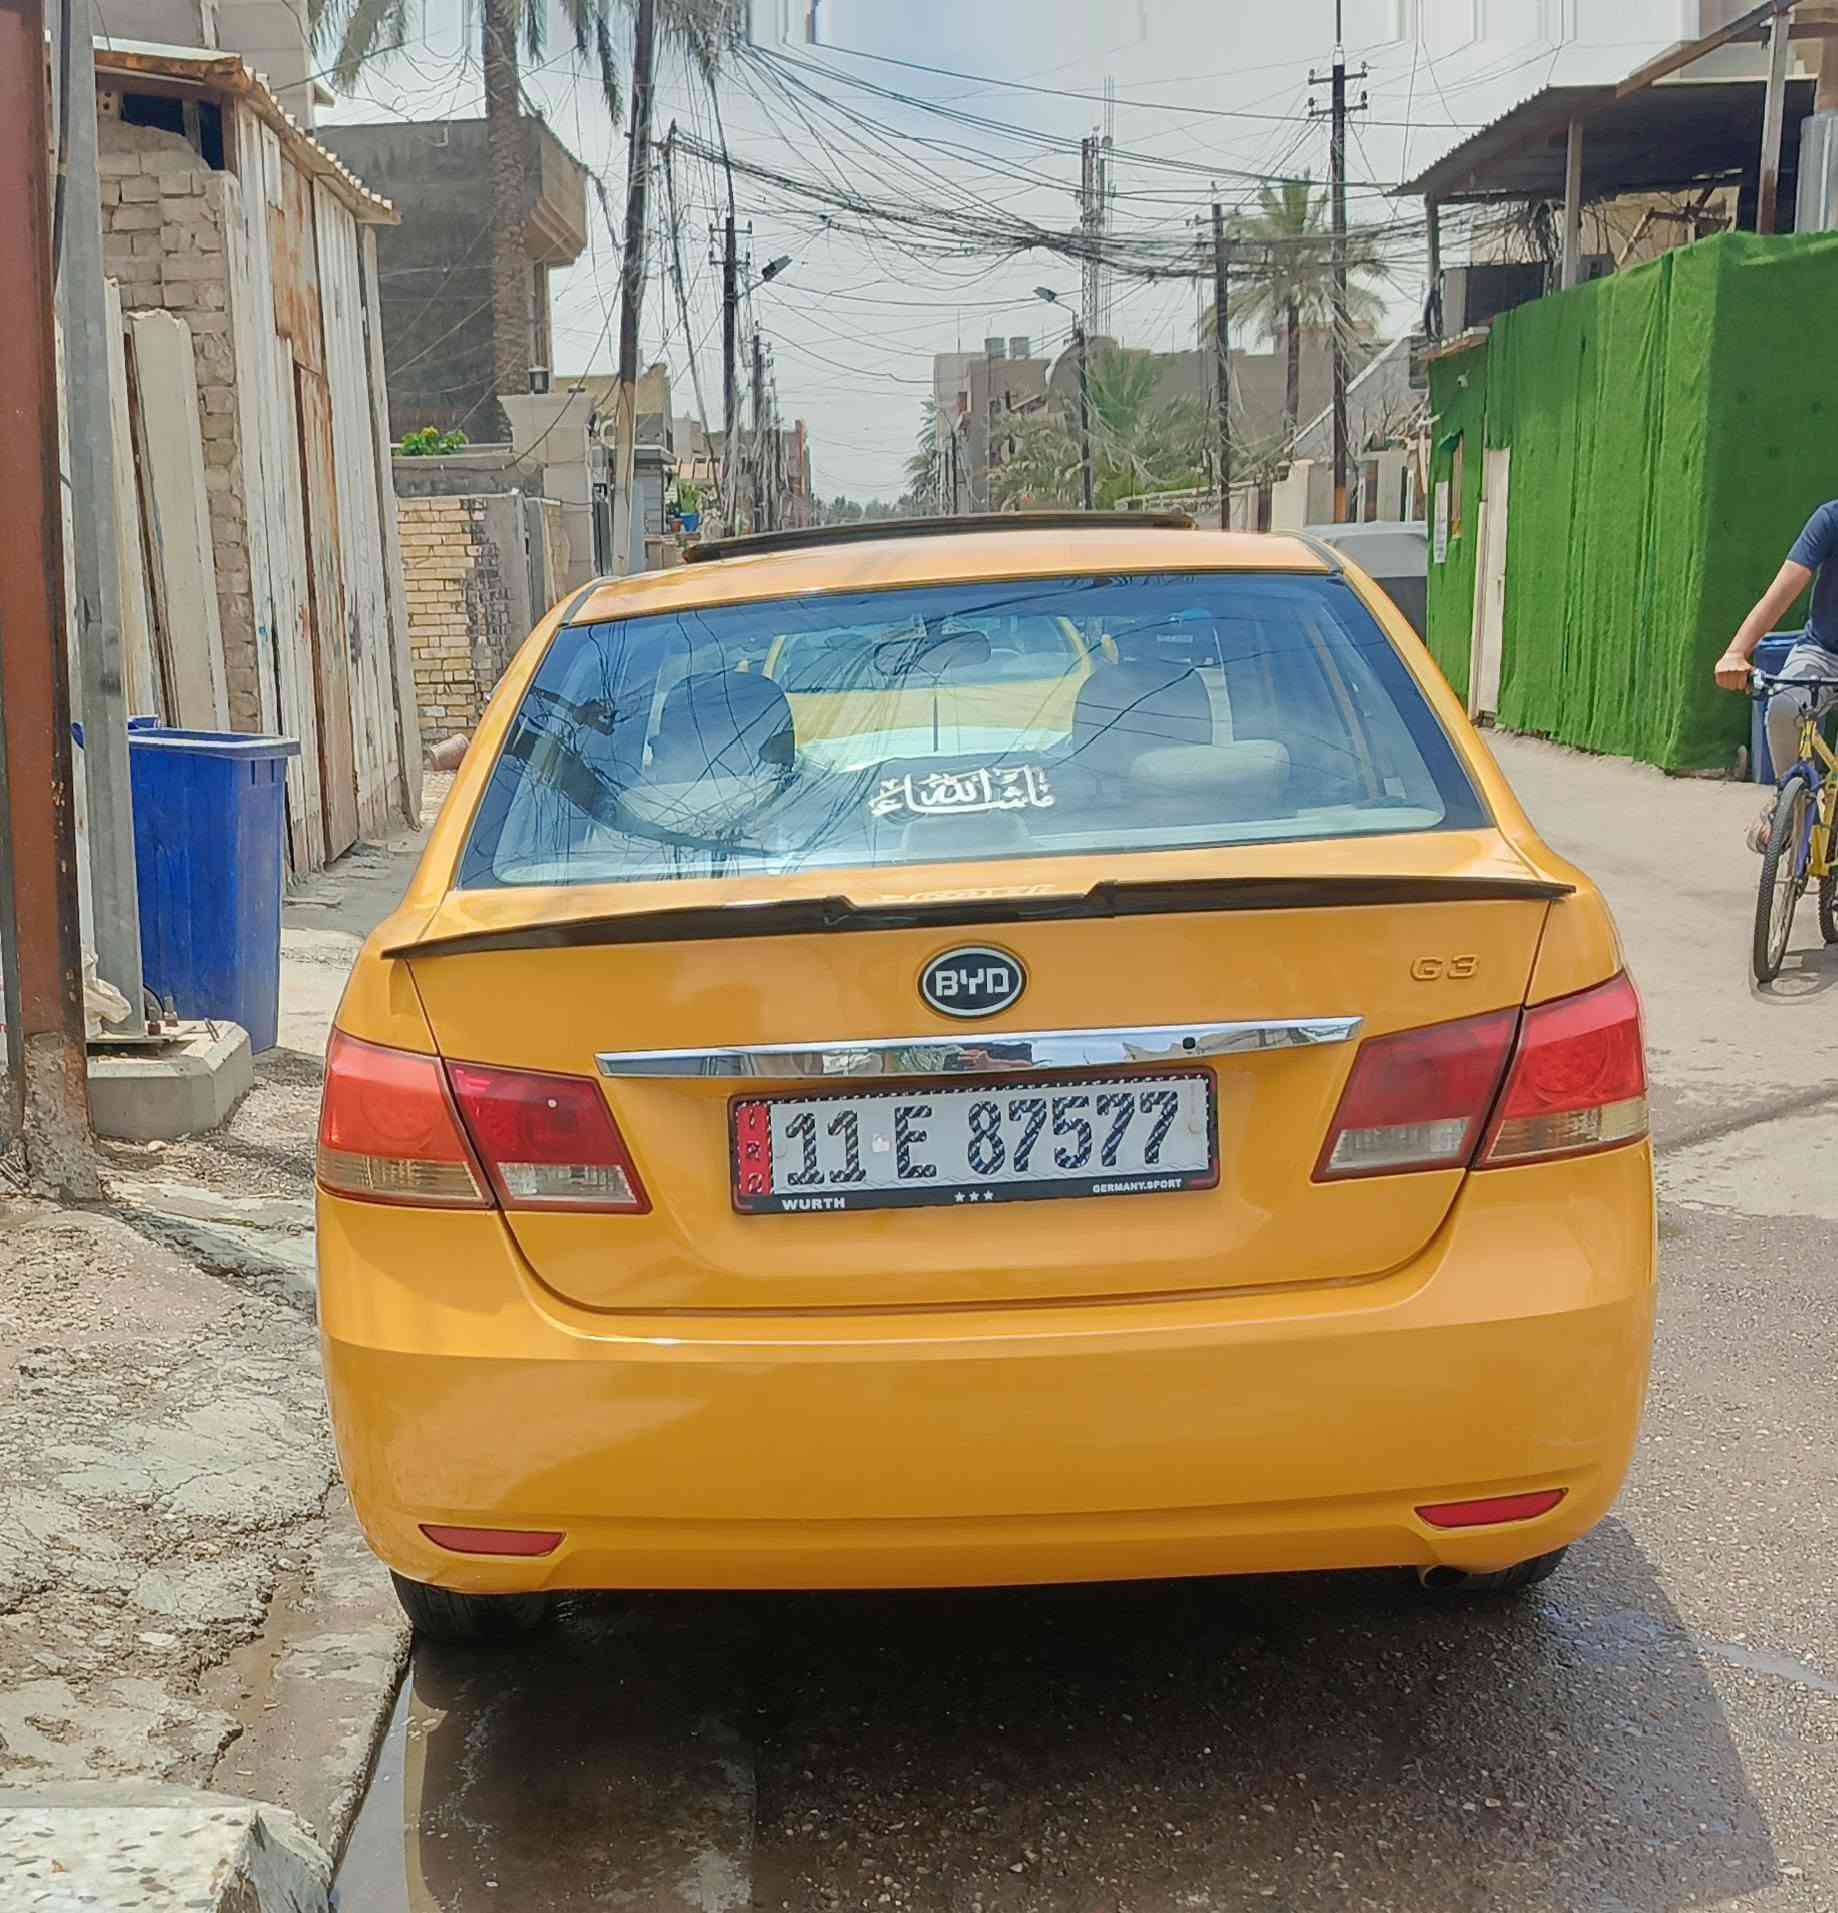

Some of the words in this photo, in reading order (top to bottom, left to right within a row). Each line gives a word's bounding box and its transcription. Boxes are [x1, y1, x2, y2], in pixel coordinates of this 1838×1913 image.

[1409, 953, 1478, 981] G3
[935, 967, 1010, 997] BYD
[786, 1110, 866, 1185] 11
[894, 1104, 937, 1179] E
[967, 1090, 1179, 1176] 87577
[781, 1197, 846, 1211] WURTH
